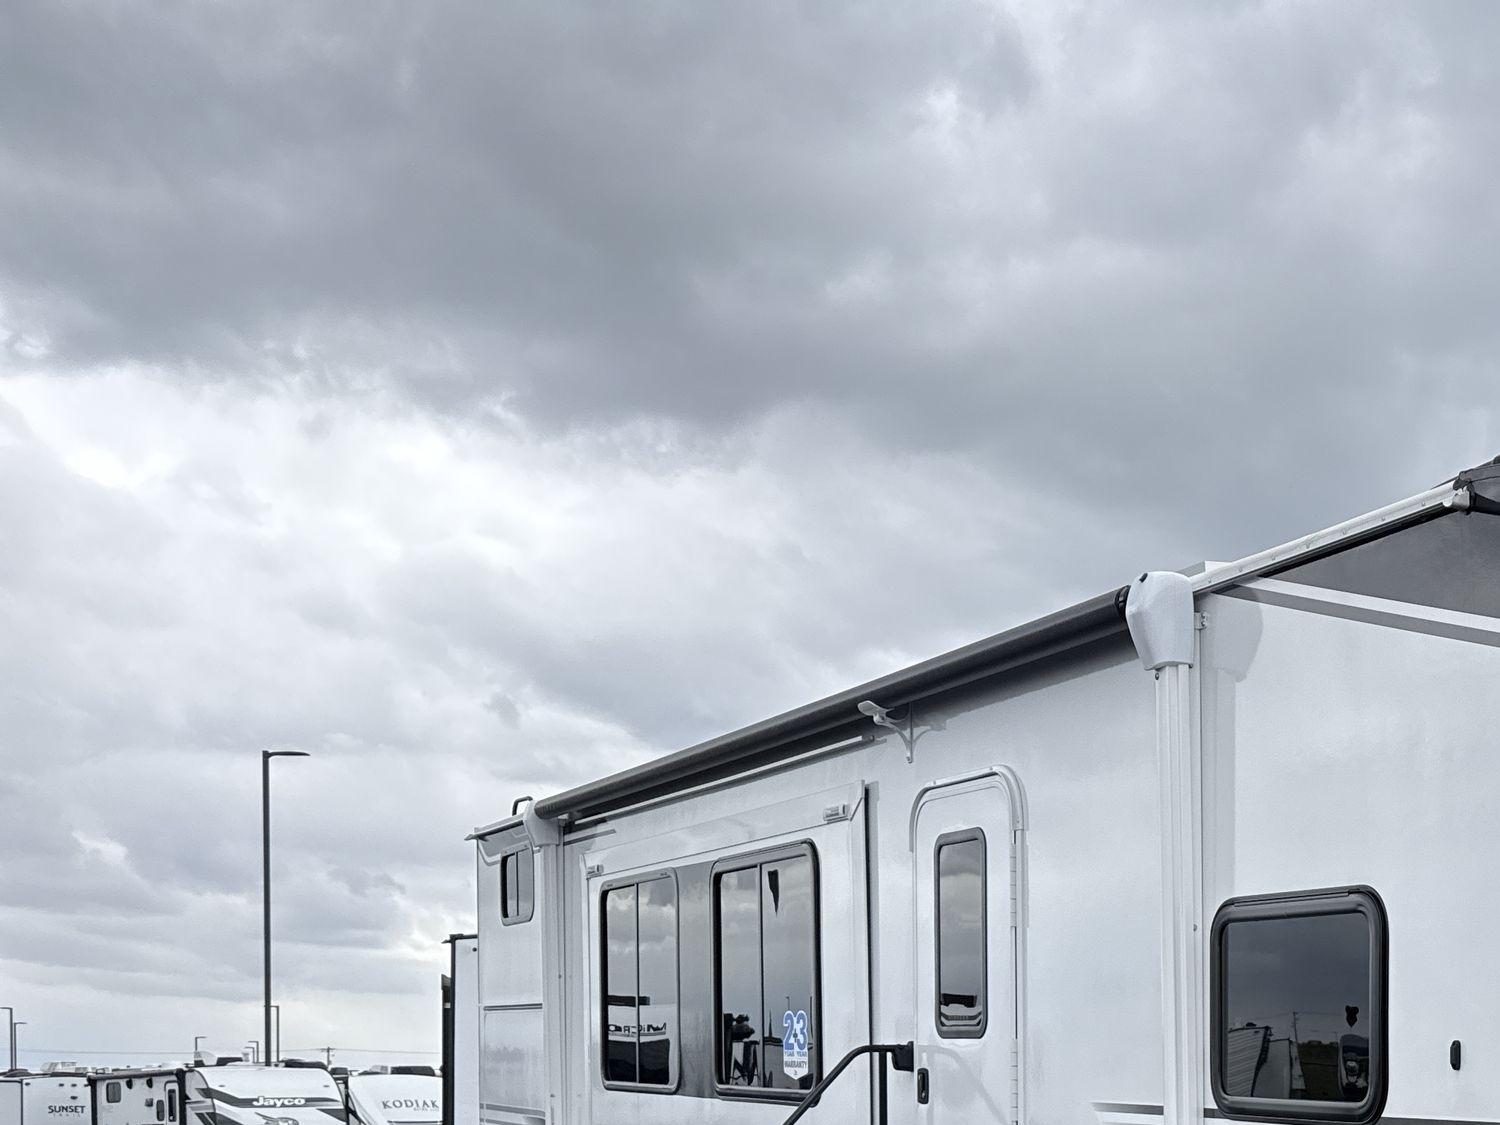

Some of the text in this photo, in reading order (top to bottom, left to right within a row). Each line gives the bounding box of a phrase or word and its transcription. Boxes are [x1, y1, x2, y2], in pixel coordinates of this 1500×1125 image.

[252, 1096, 306, 1108] Jayco
[382, 1099, 440, 1109] KODIAK
[47, 1105, 86, 1114] SUNSET
